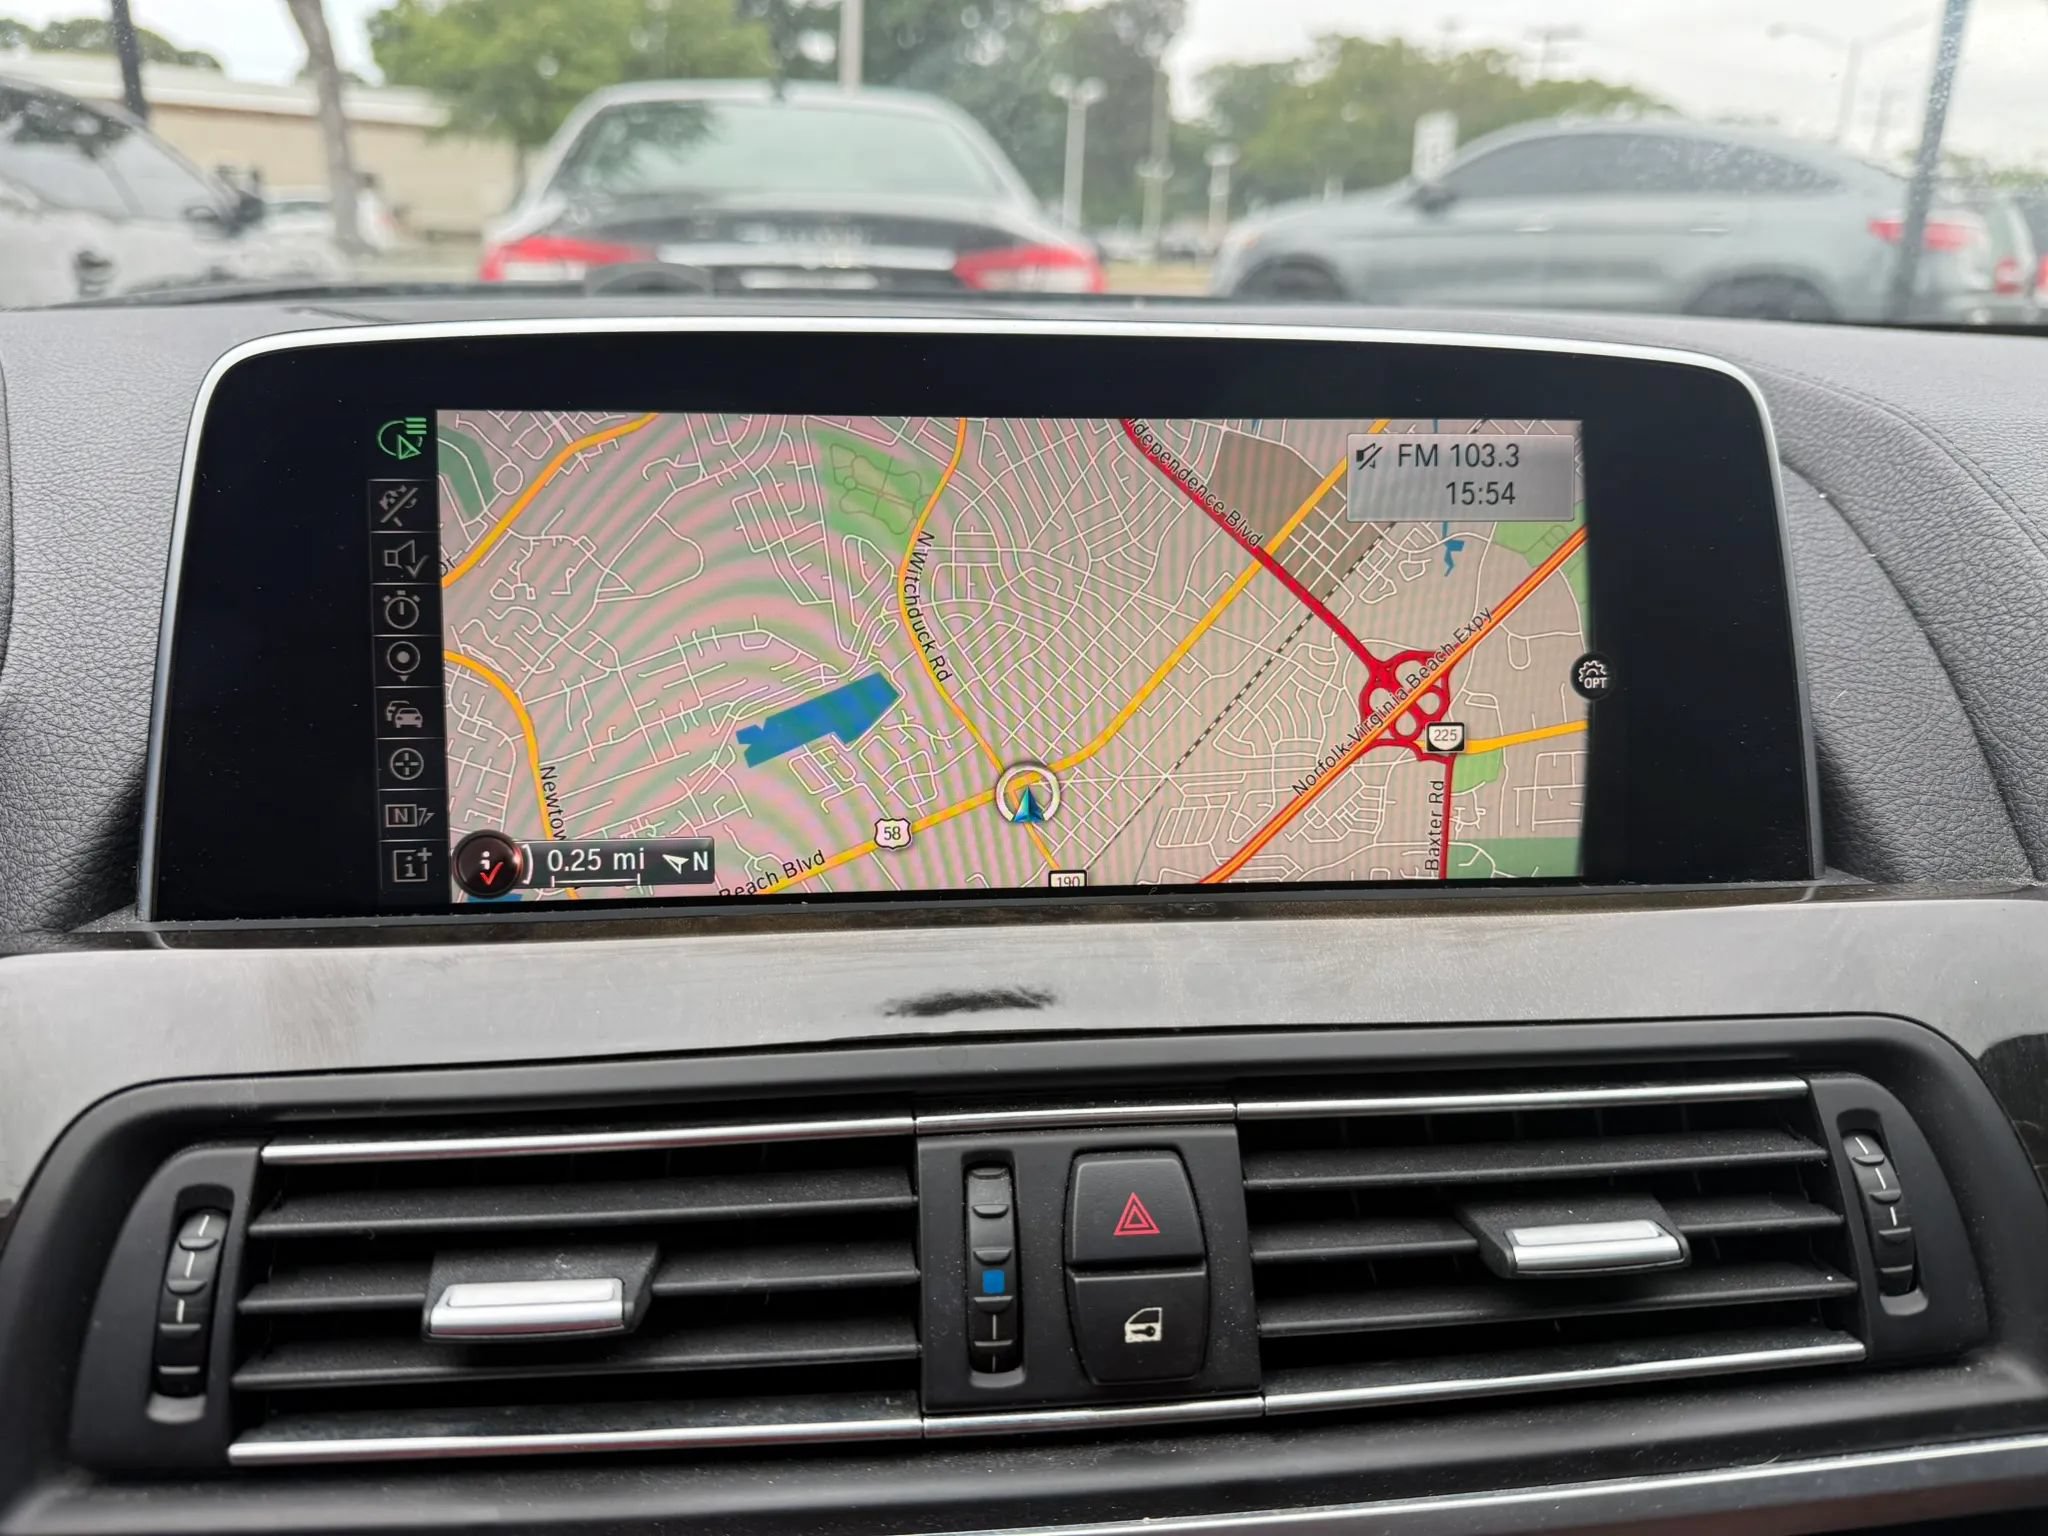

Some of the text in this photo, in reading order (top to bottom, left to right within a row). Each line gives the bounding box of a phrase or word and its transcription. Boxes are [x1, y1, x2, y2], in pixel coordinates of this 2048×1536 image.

[1398, 443, 1520, 468] FM 103.3
[1446, 481, 1517, 506] 15:54
[1224, 510, 1264, 547] Blvd
[904, 530, 953, 683] N Witchduck Rd
[1583, 677, 1608, 689] OPT
[1291, 606, 1494, 797] Norfolk-Virginia Beach Expy
[1433, 728, 1458, 742] 225
[883, 826, 902, 841] 58
[1424, 780, 1445, 871] Baxter Rd
[547, 847, 645, 872] 0.25 mi
[692, 850, 709, 872] N
[782, 849, 826, 880] Blvd
